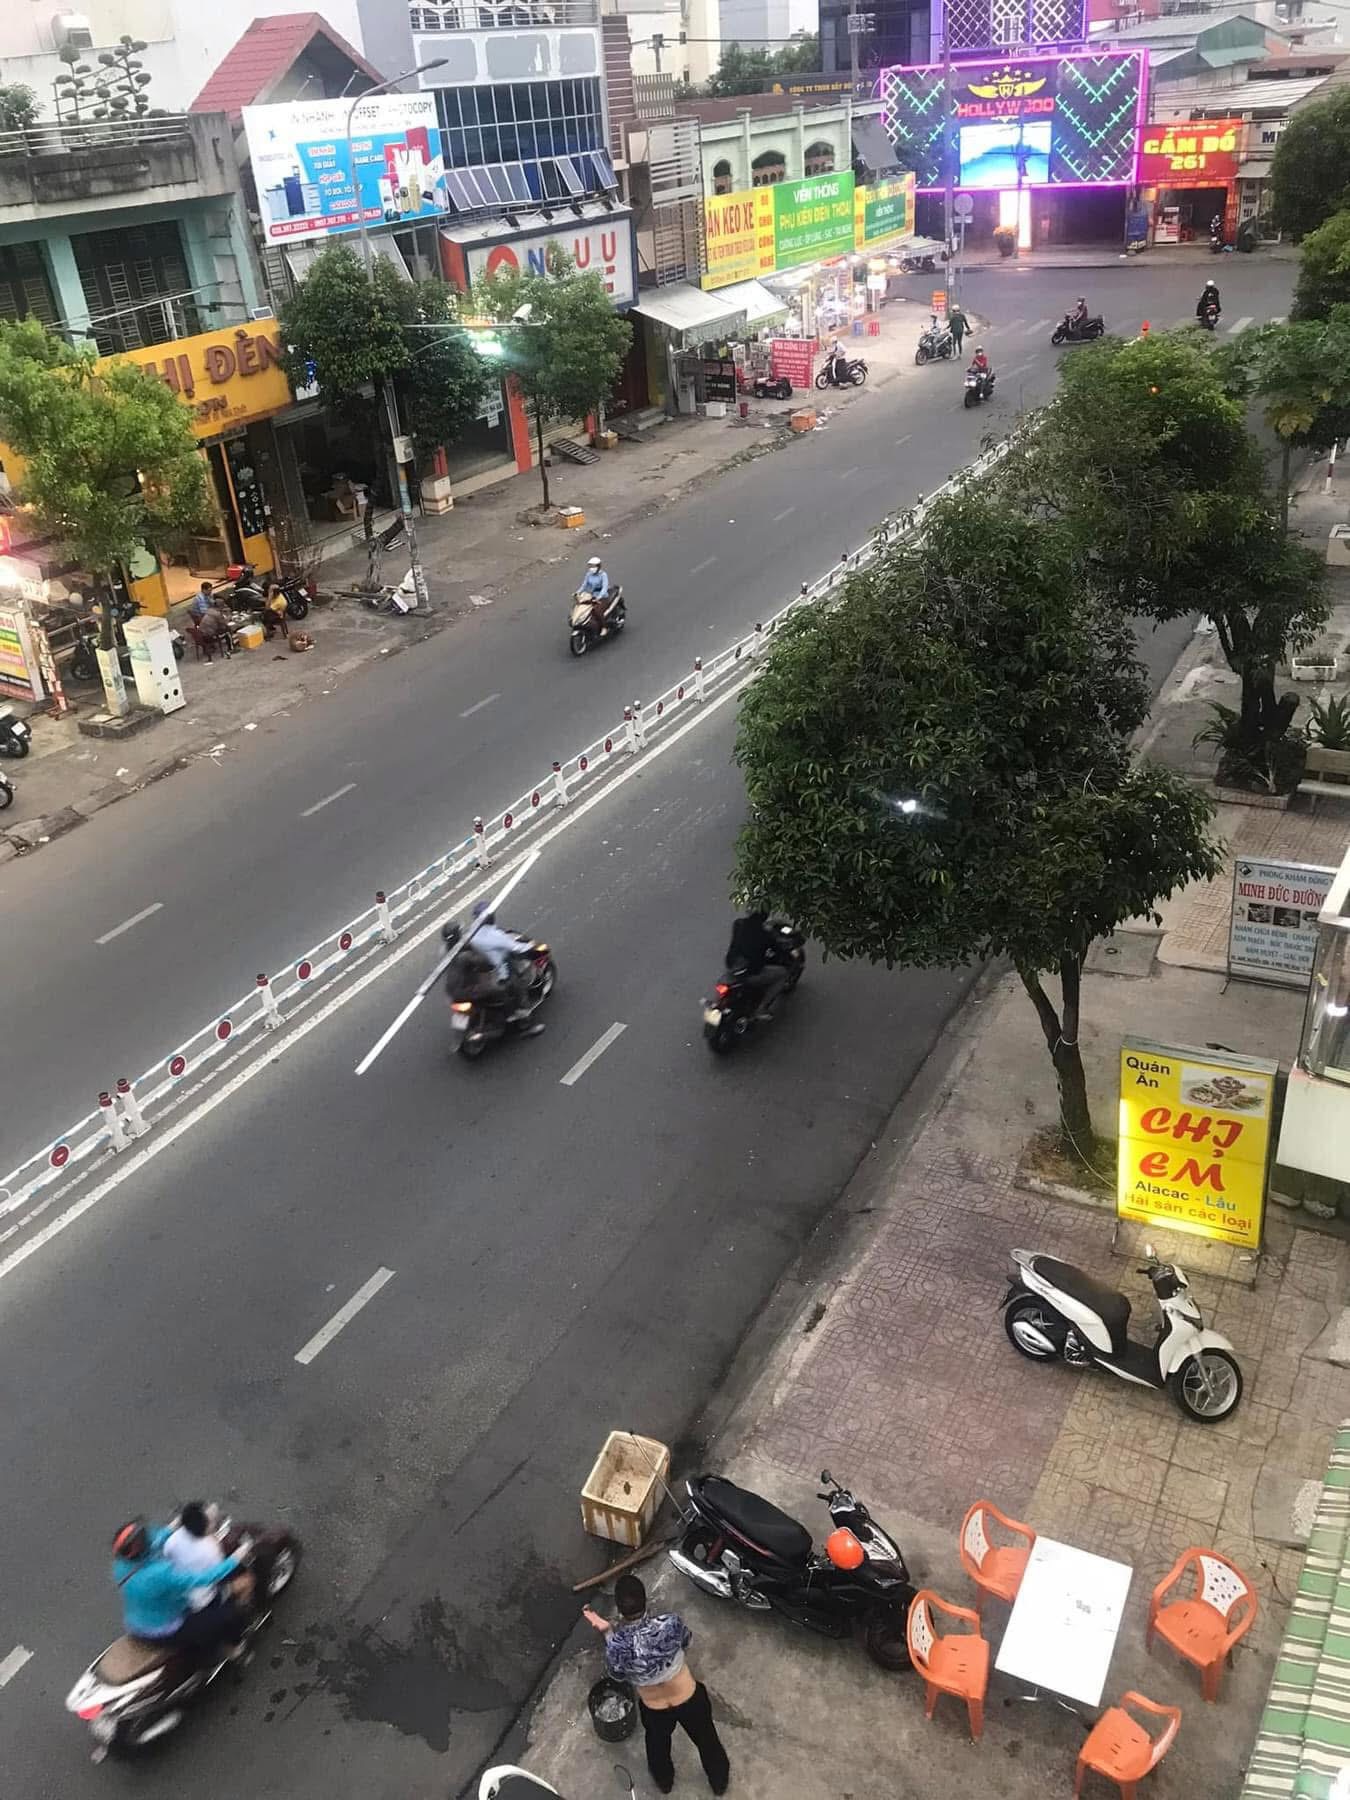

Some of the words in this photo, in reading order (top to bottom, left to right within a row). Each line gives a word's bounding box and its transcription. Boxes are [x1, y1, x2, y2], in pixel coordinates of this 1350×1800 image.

[1170, 155, 1206, 170] 261
[705, 200, 721, 239] ÁN
[1238, 882, 1265, 899] MINH
[1267, 883, 1290, 903] ĐỨC
[1126, 1056, 1171, 1076] Quán
[1136, 1071, 1159, 1088] Ăn
[1140, 1107, 1244, 1158] CHỊ
[1135, 1180, 1190, 1201] Alacac
[1188, 1207, 1217, 1222] các
[1222, 1214, 1252, 1231] loại
